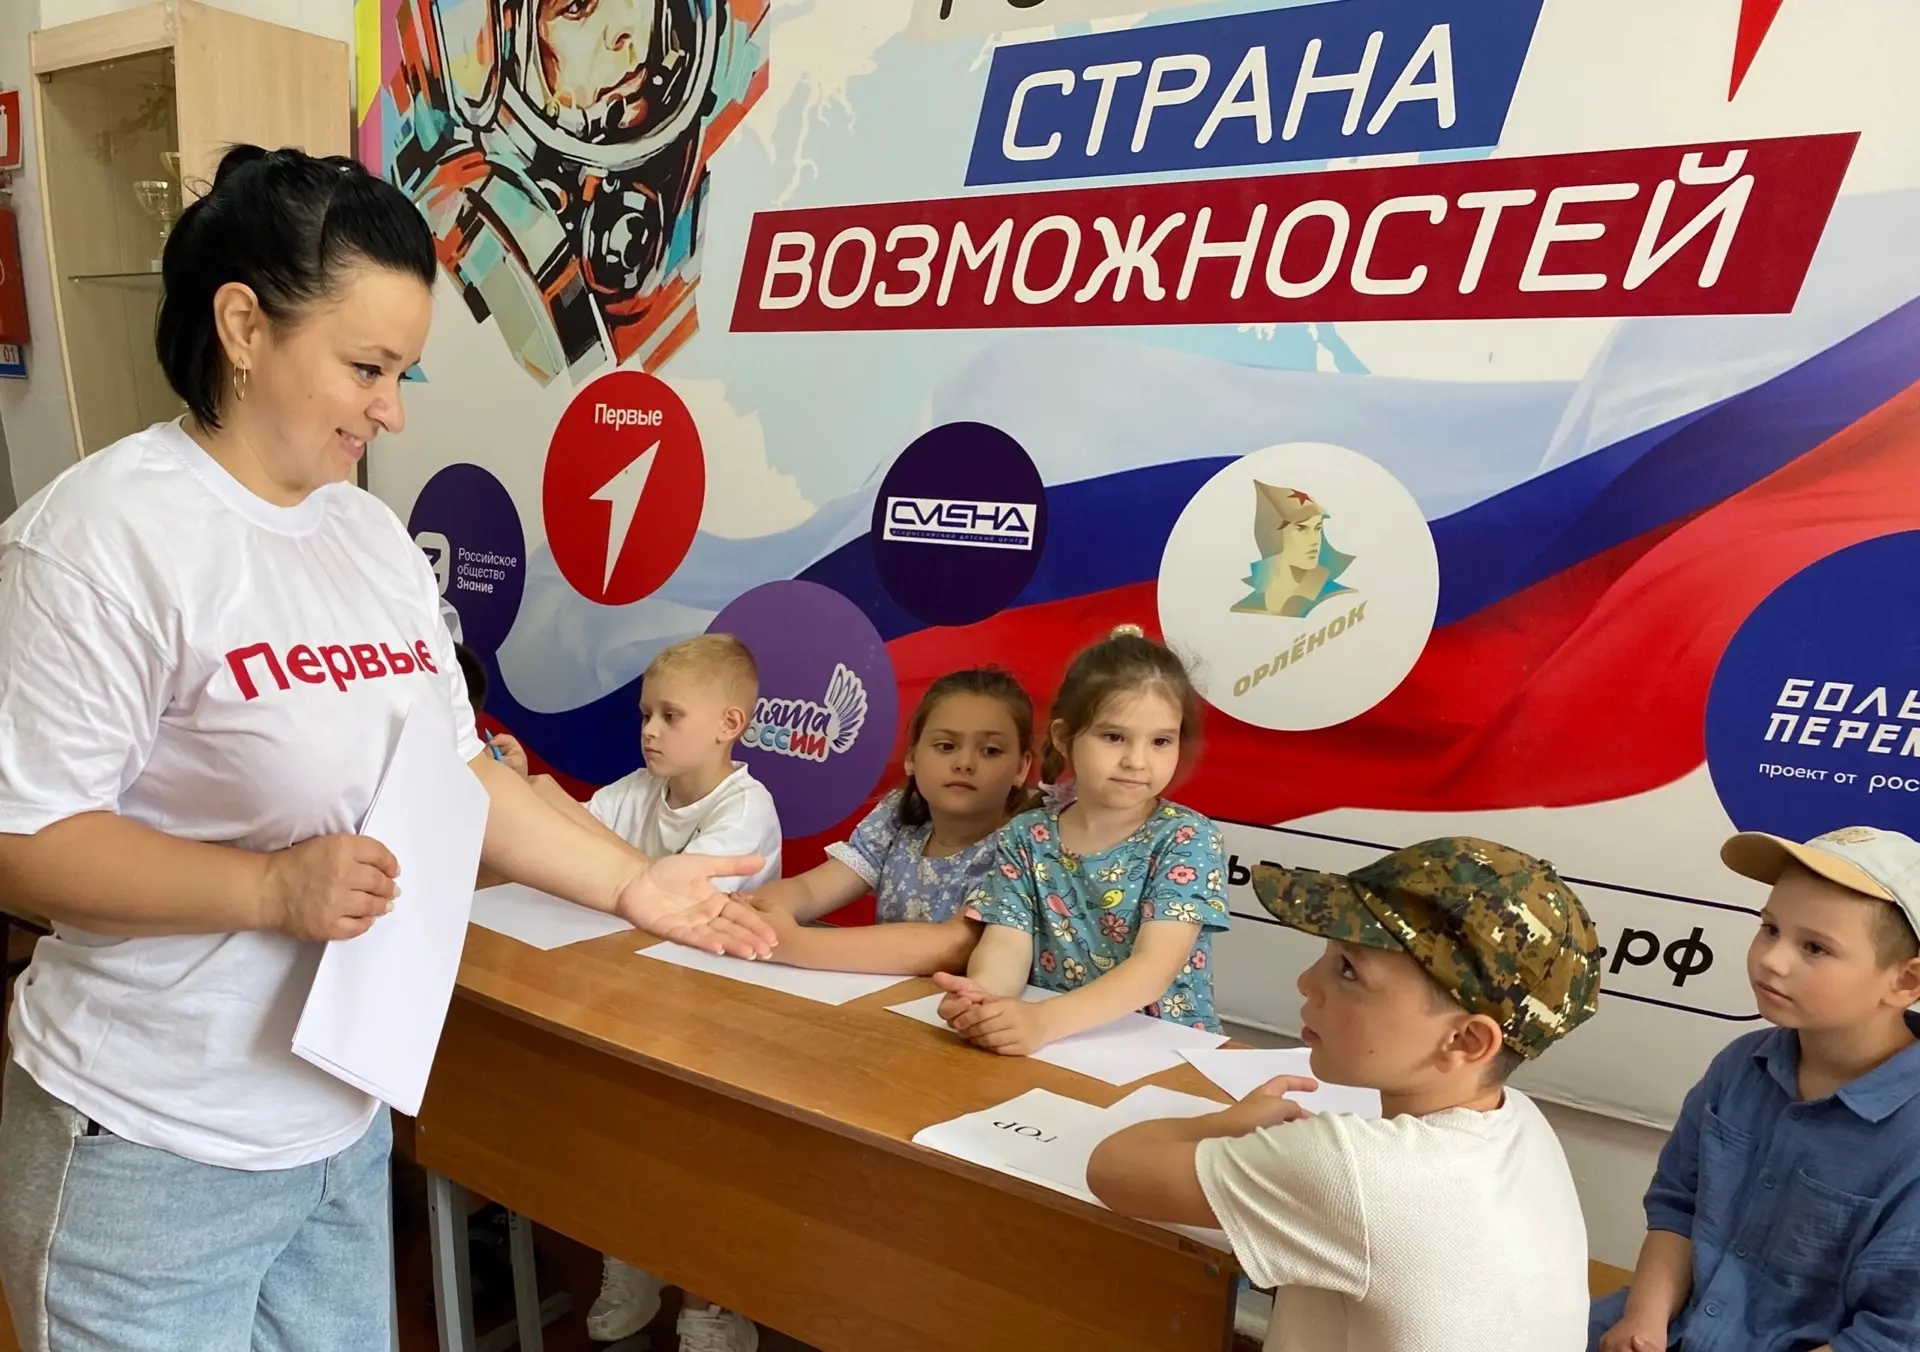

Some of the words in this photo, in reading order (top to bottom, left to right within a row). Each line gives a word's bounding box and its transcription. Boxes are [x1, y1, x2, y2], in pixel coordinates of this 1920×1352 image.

[1002, 23, 1456, 162] СТРАНА
[759, 148, 1755, 310] ВОЗМОЖНОСТЕЙ
[594, 403, 663, 431] Первые
[891, 501, 1030, 532] СМЕНА
[457, 563, 506, 581] общество
[458, 547, 517, 567] Российское
[456, 576, 494, 594] Знание
[1233, 600, 1369, 697] ОРЛЁНОК
[225, 639, 439, 702] Первые
[1776, 678, 1920, 720] БОЛЬ
[752, 702, 832, 737] лята
[743, 724, 827, 758] оссии
[1759, 763, 1828, 781] проект
[1834, 772, 1858, 784] от
[1868, 774, 1920, 793] рос
